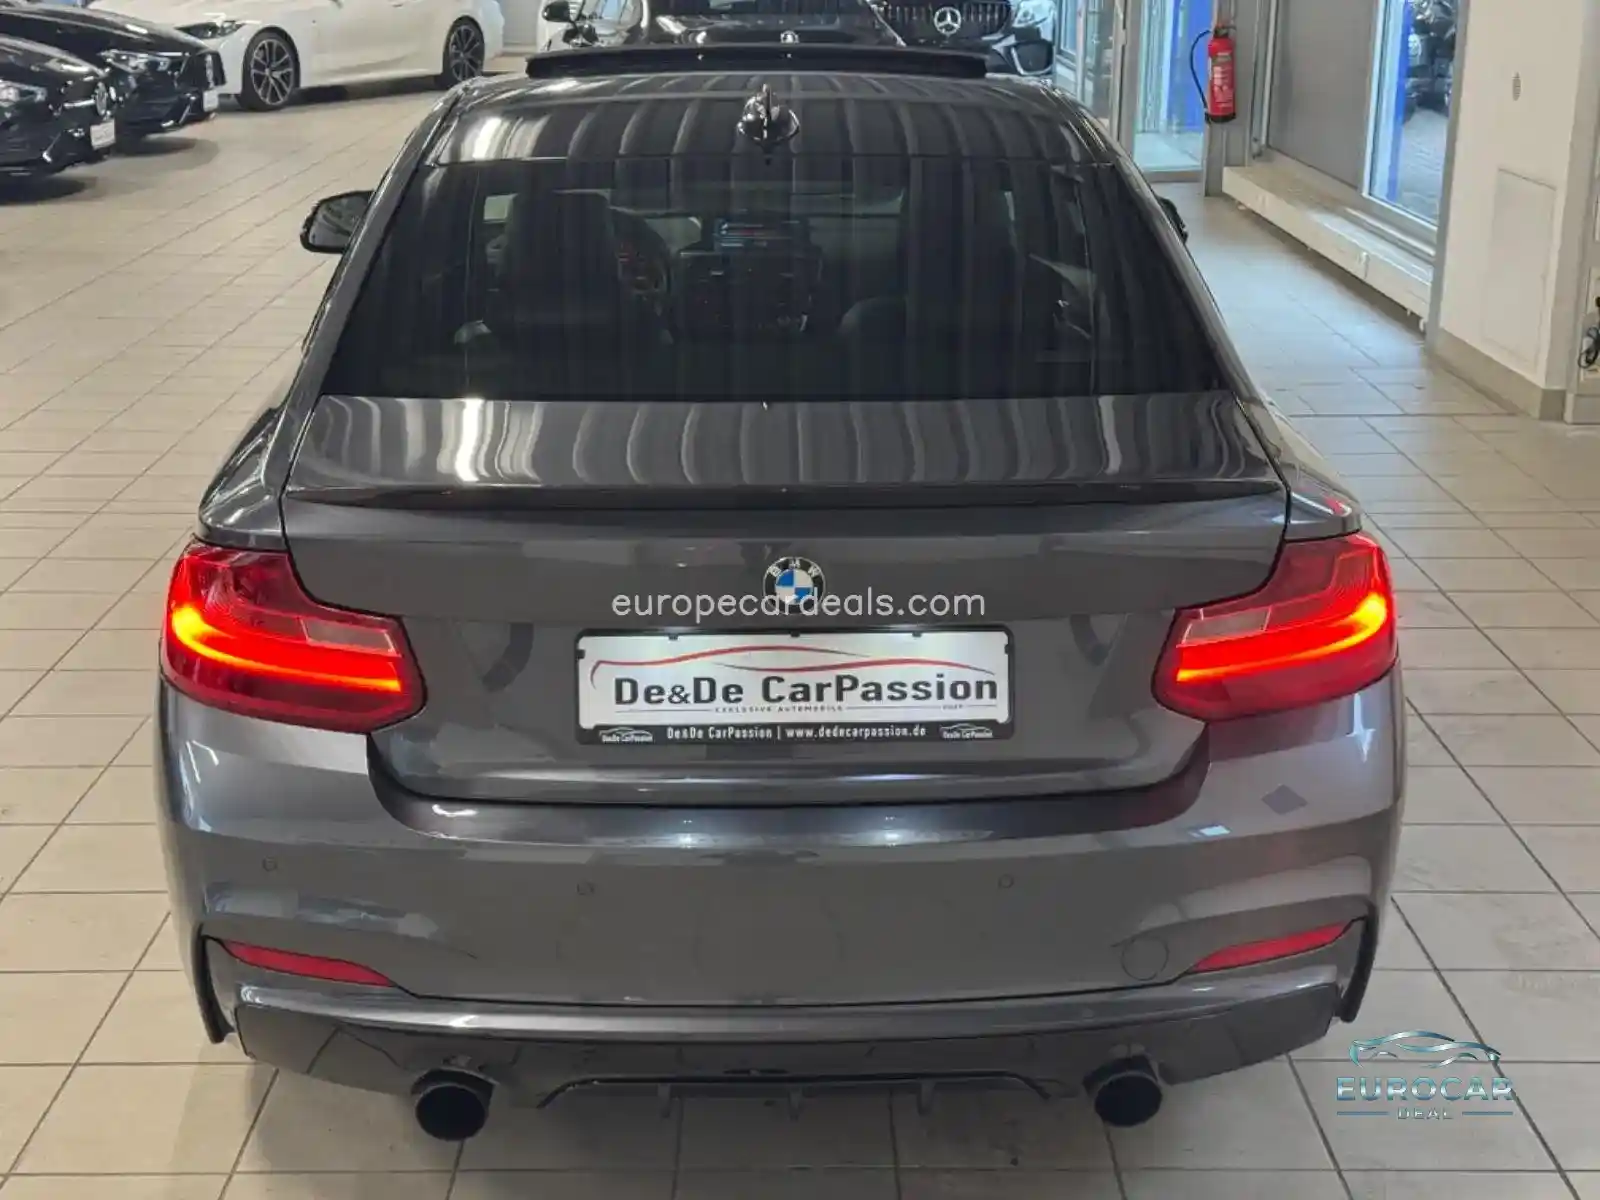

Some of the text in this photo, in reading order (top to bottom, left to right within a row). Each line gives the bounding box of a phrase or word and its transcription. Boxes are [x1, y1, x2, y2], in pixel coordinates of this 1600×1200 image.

[614, 673, 998, 705] De&De CarPassion
[667, 726, 704, 739] De&De
[708, 725, 773, 739] CarPassion
[785, 724, 927, 740] www.dedecarpassion.de
